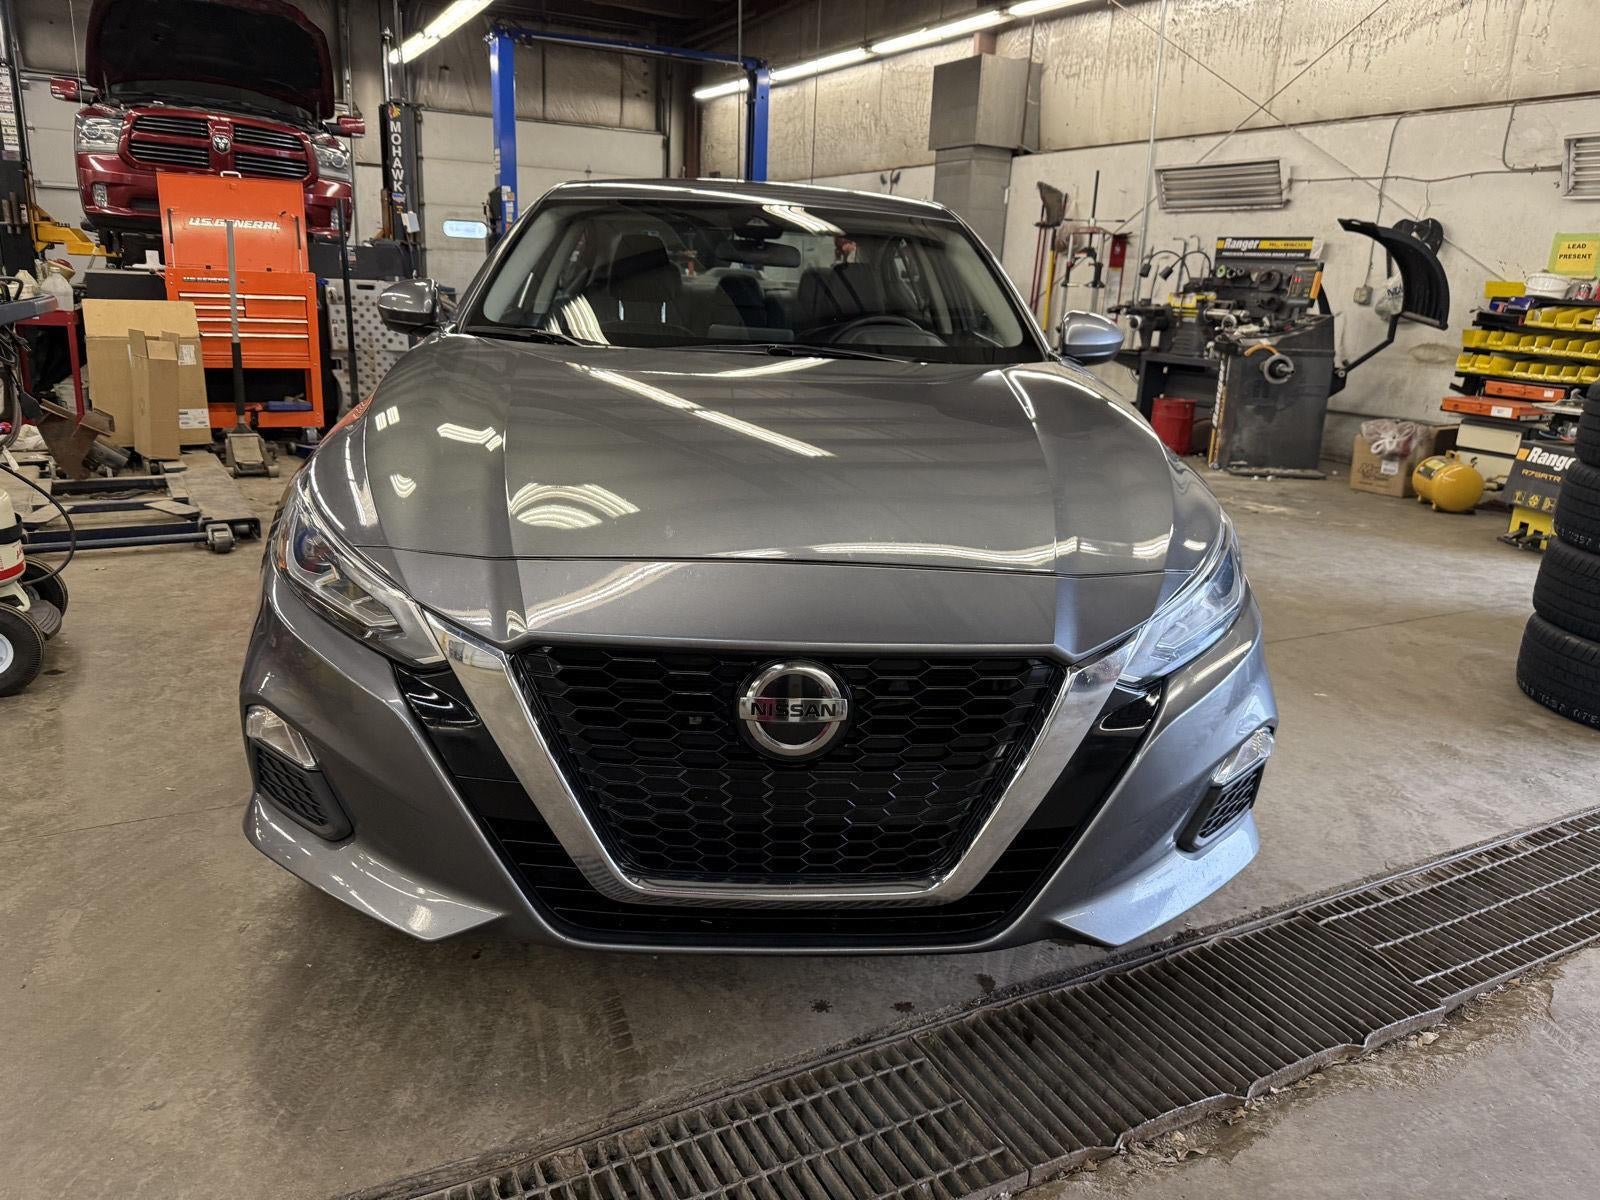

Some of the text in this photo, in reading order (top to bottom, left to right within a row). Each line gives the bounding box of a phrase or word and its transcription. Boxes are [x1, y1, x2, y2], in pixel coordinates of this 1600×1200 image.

[389, 121, 404, 192] MOHAWK
[1223, 238, 1260, 251] Ranger
[750, 702, 837, 718] NISSAN
